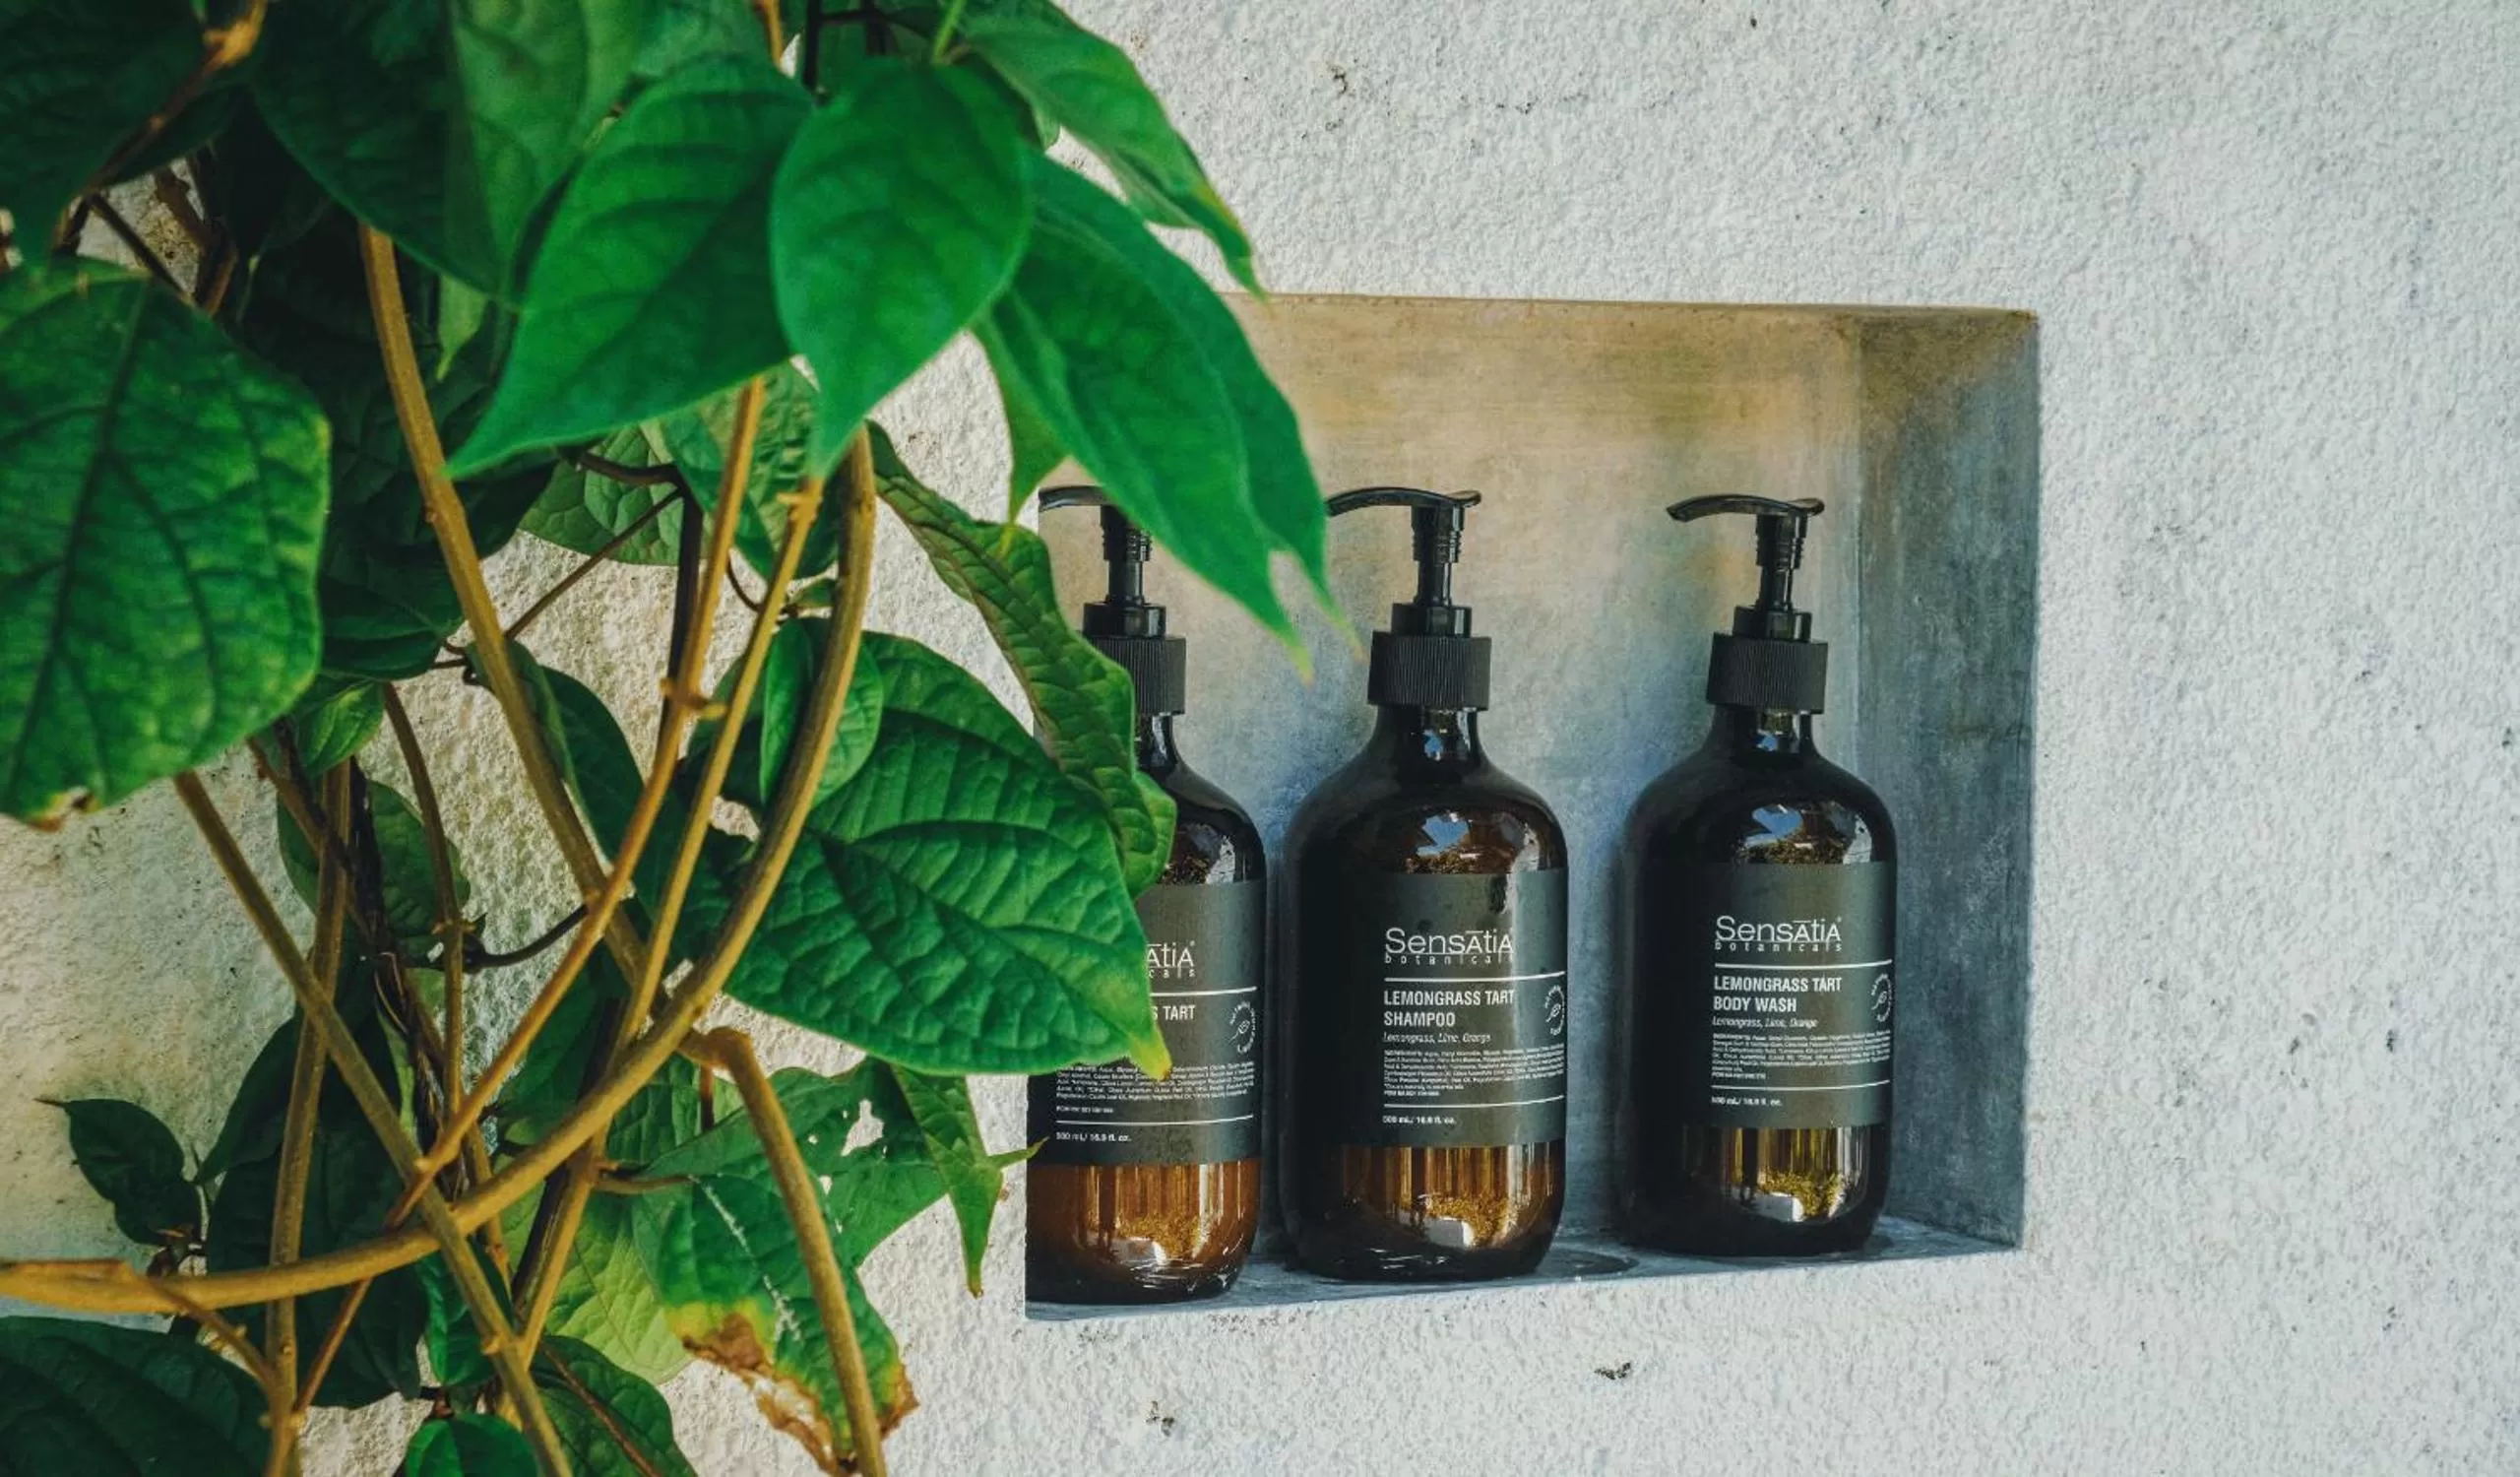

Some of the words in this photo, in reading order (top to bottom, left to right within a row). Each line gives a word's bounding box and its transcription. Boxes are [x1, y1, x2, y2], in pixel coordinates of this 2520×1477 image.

[1714, 975, 1809, 993] LEMONGRASS
[1811, 976, 1843, 993] TART
[1383, 990, 1480, 1005] LEMONGRASS
[1484, 989, 1515, 1004] TART
[1713, 995, 1751, 1011] BODY
[1754, 997, 1797, 1012] WASH
[1163, 1004, 1196, 1021] TART
[1383, 1010, 1456, 1027] SHAMPOO
